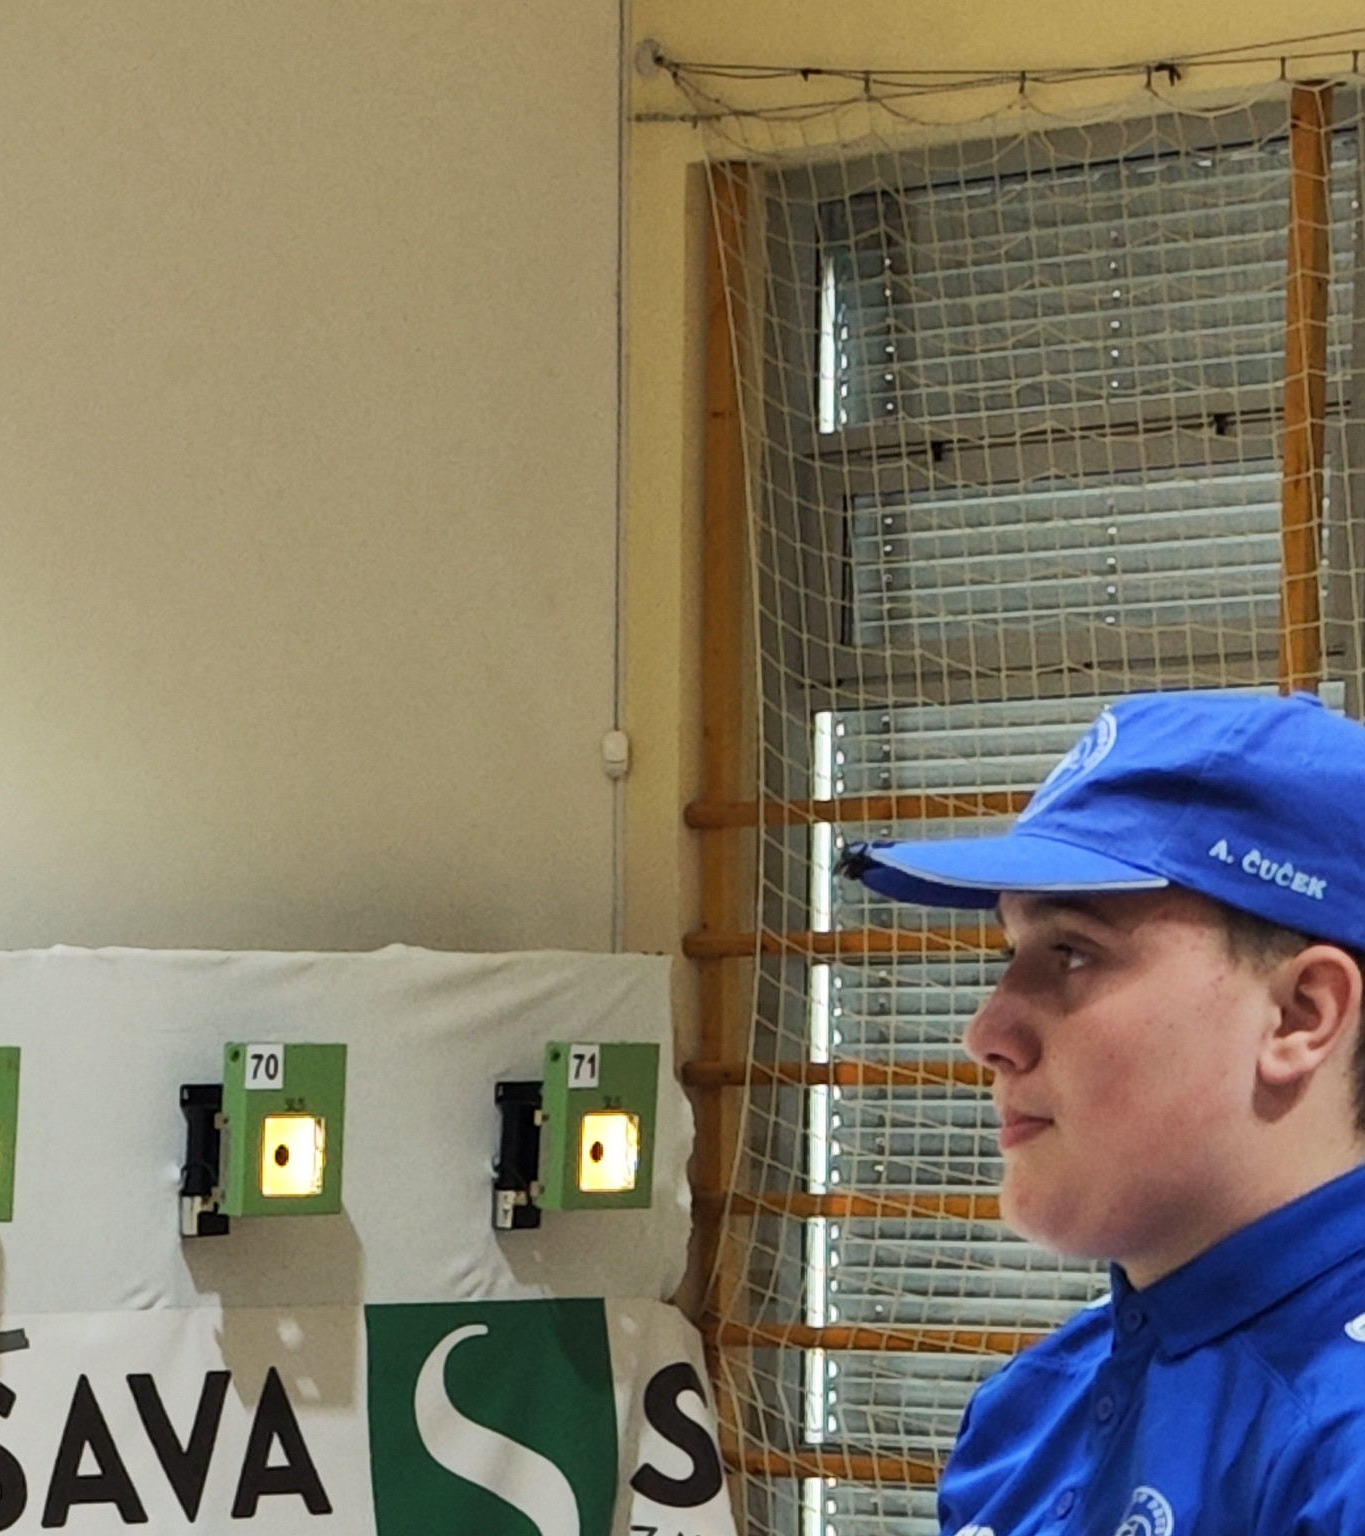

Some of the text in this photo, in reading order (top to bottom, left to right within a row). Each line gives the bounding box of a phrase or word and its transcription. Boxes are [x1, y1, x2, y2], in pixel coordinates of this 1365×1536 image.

[1209, 839, 1327, 899] A. ČUČEK
[250, 1053, 279, 1081] 70
[572, 1052, 596, 1080] 71
